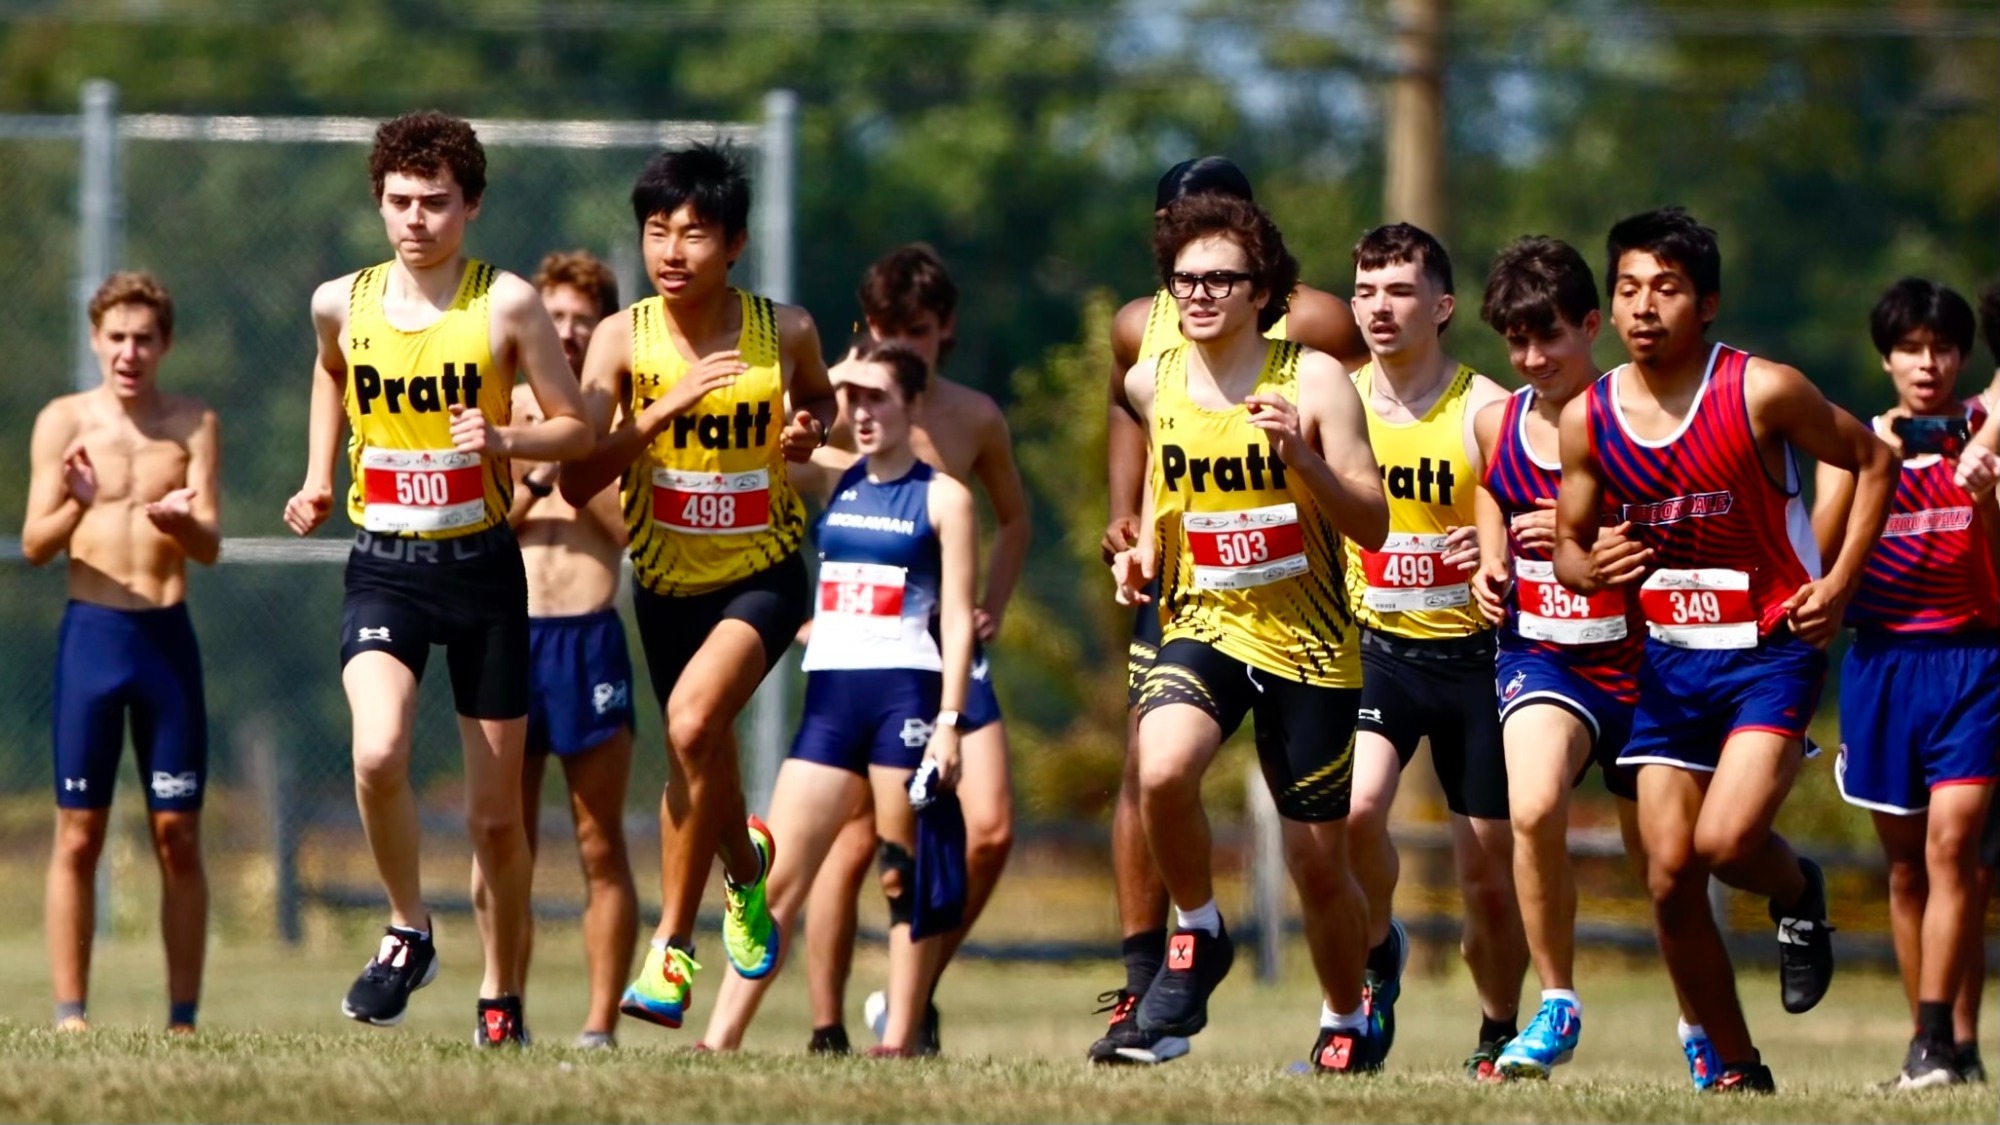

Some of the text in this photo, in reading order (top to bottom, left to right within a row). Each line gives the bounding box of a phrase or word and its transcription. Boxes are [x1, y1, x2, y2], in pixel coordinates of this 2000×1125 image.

[354, 363, 481, 415] Pratt
[643, 397, 771, 450] ratt
[1162, 443, 1287, 492] Pratt
[1379, 456, 1455, 506] att
[395, 471, 448, 506] 500
[682, 494, 736, 528] 498
[826, 512, 915, 536] MORAVIAN
[1215, 531, 1268, 566] 503
[1383, 554, 1435, 587] 499
[836, 583, 875, 618] 154
[1538, 583, 1590, 618] 354
[1669, 591, 1721, 624] 349
